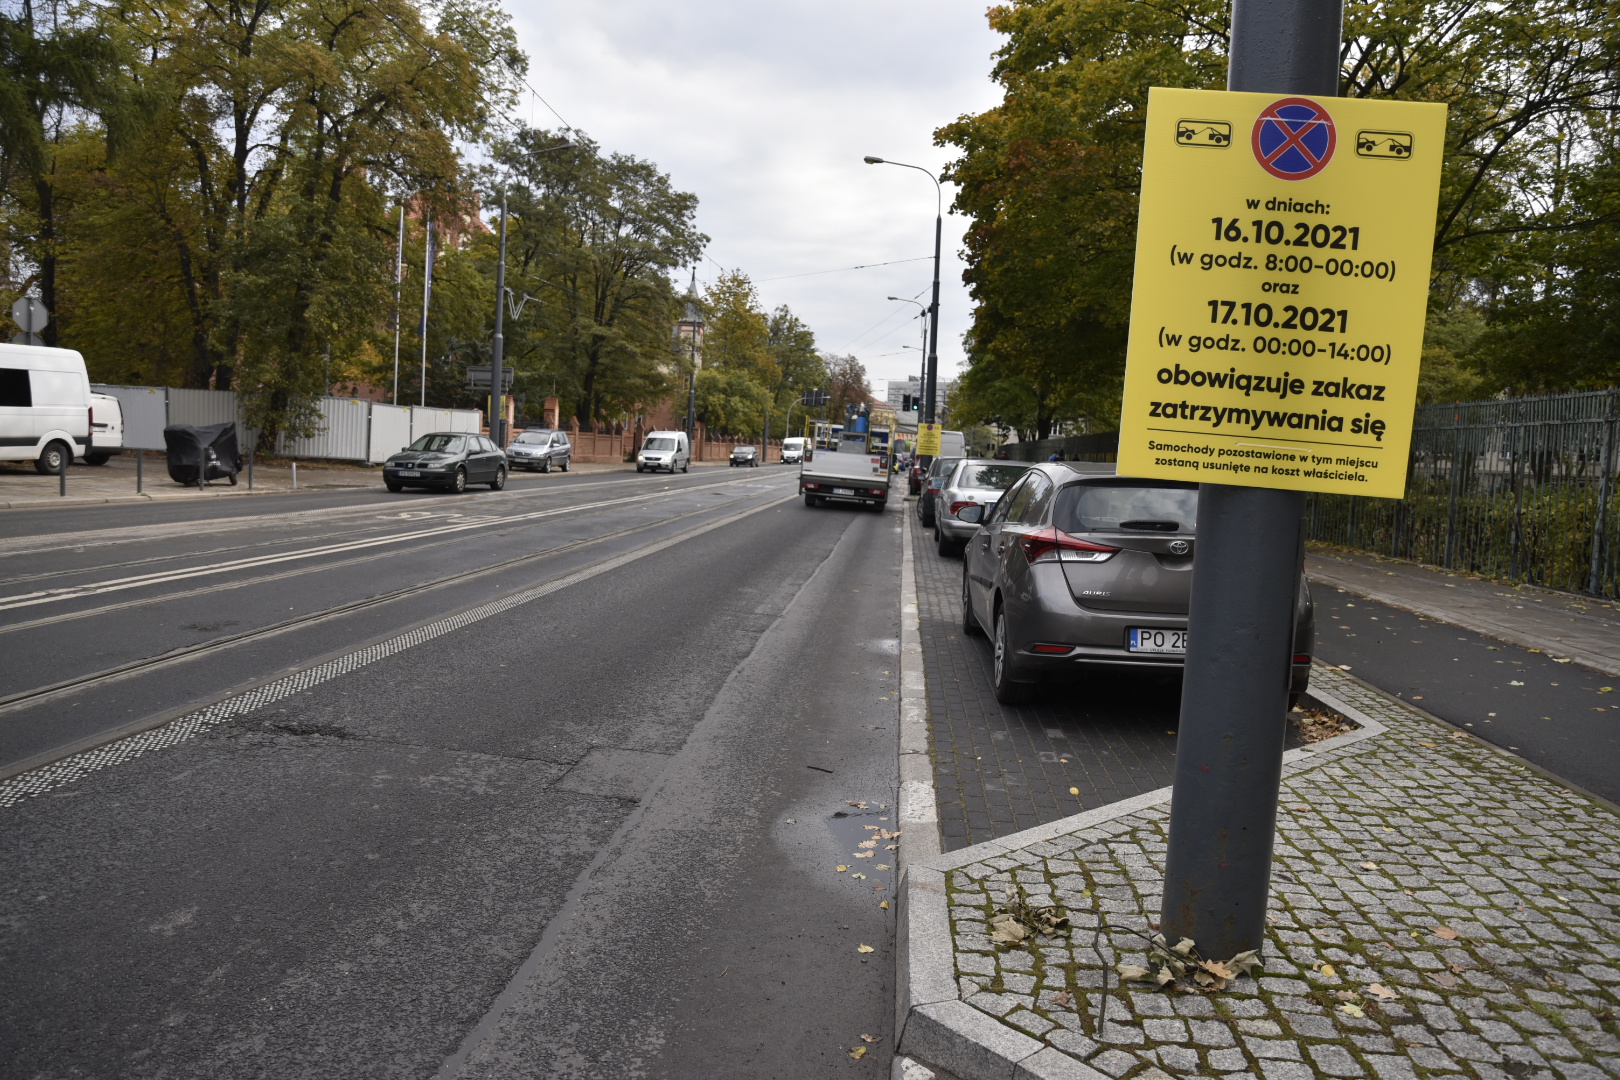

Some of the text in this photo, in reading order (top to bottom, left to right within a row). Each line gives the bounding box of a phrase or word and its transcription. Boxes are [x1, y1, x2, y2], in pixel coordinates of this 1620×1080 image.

[1246, 196, 1330, 215] w dniach:
[1211, 216, 1360, 251] 16.10.2021
[1170, 244, 1396, 282] (w godz. 8:00-00:00)
[1261, 281, 1300, 295] oraz
[1207, 299, 1348, 334] 17.10.2021
[1158, 326, 1391, 365] (w godz. 00:00-14:00)
[1156, 363, 1386, 402] obowiązuje zakaz
[1148, 400, 1386, 441] zatrzymywania się
[1148, 440, 1378, 469] Samochody pozostawione w tym miejscu
[1154, 457, 1368, 482] zostaną usunięte na koszt właściciela.
[1140, 630, 1165, 648] PO
